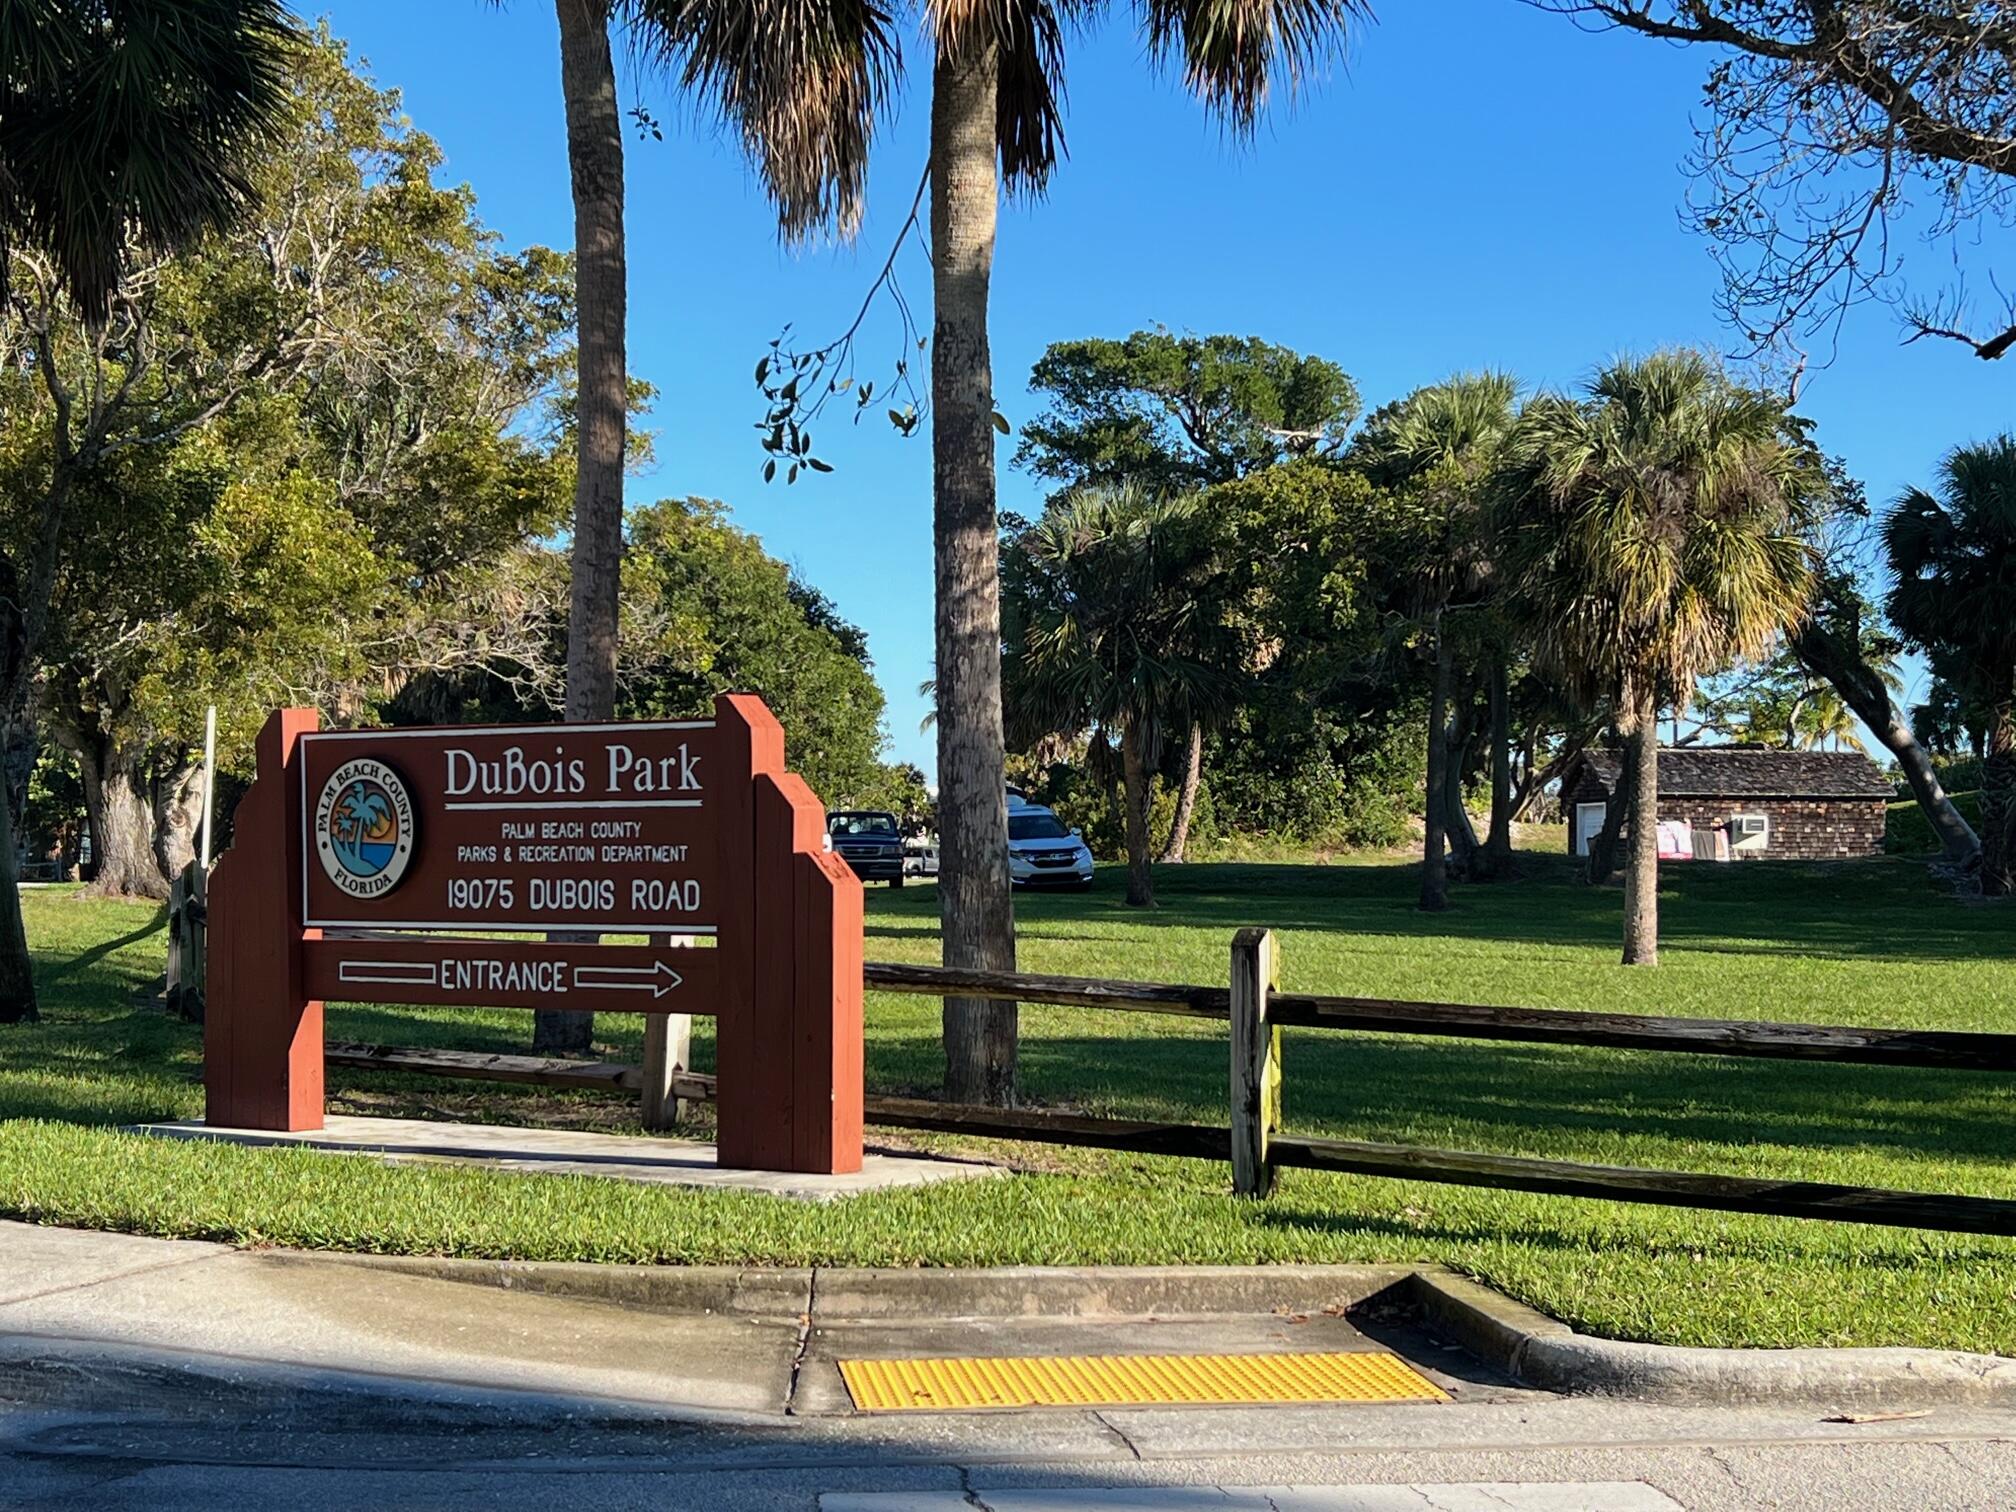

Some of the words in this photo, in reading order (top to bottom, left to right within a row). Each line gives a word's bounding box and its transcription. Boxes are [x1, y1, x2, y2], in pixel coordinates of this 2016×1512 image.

[443, 745, 585, 796] DuBois
[605, 743, 703, 793] Park
[317, 786, 336, 833] PALM
[336, 763, 380, 788] BEACH
[382, 770, 412, 839] COUNTY
[502, 822, 535, 839] PALM
[542, 822, 584, 839] BEACH
[590, 821, 642, 838] COUNTY
[457, 846, 497, 862] PARKS
[503, 846, 513, 862] &
[518, 846, 595, 863] RECREATION
[602, 845, 688, 862] DEPARTMENT
[333, 868, 393, 895] FLORIDA
[447, 879, 514, 910] 19075
[529, 879, 615, 911] DUBOIS
[631, 879, 701, 912] ROAD
[440, 959, 568, 993] ENTRANCE
